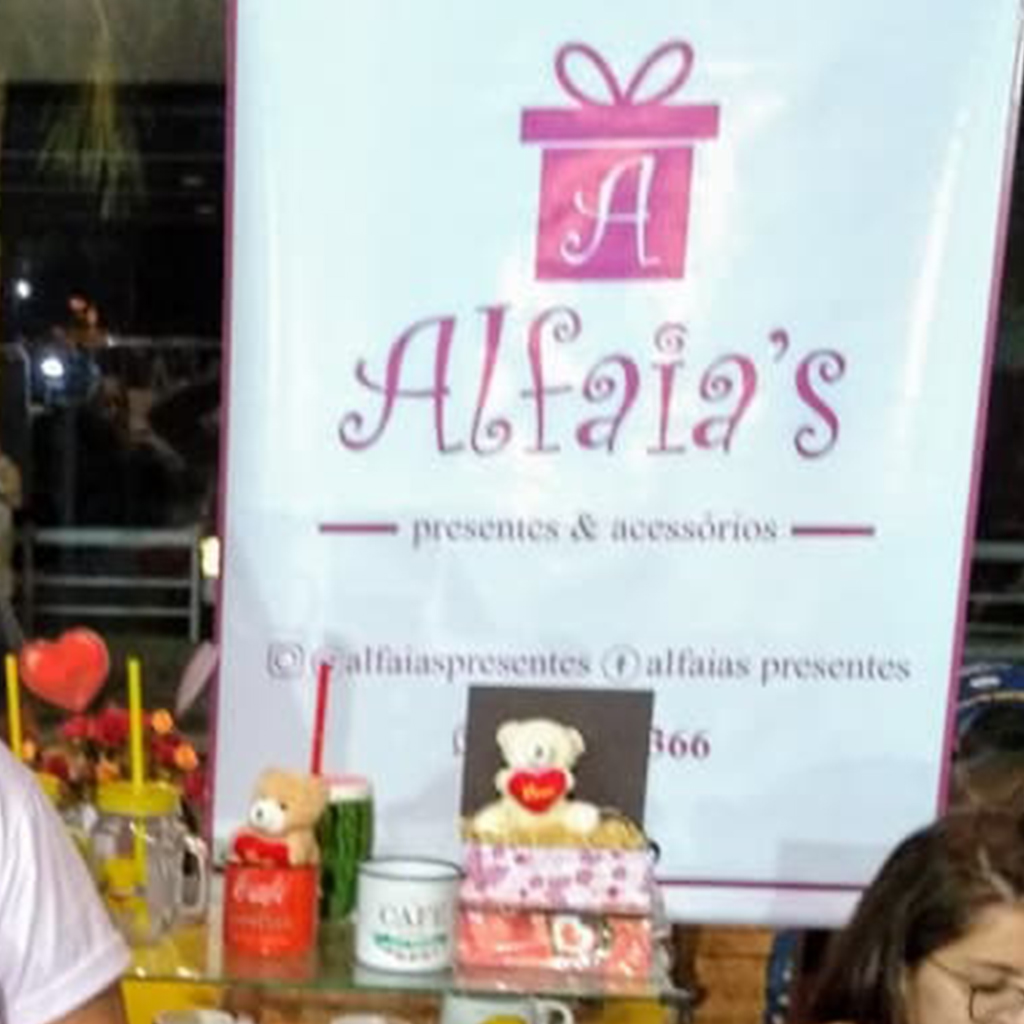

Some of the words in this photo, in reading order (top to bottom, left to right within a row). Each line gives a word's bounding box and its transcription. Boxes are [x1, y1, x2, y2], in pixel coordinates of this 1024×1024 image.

[559, 154, 661, 266] A
[337, 304, 848, 460] Alfaia's
[411, 517, 559, 550] presentes
[569, 513, 598, 541] &
[611, 512, 778, 542] acessórios
[645, 645, 750, 678] alfaias
[760, 650, 912, 686] presentes
